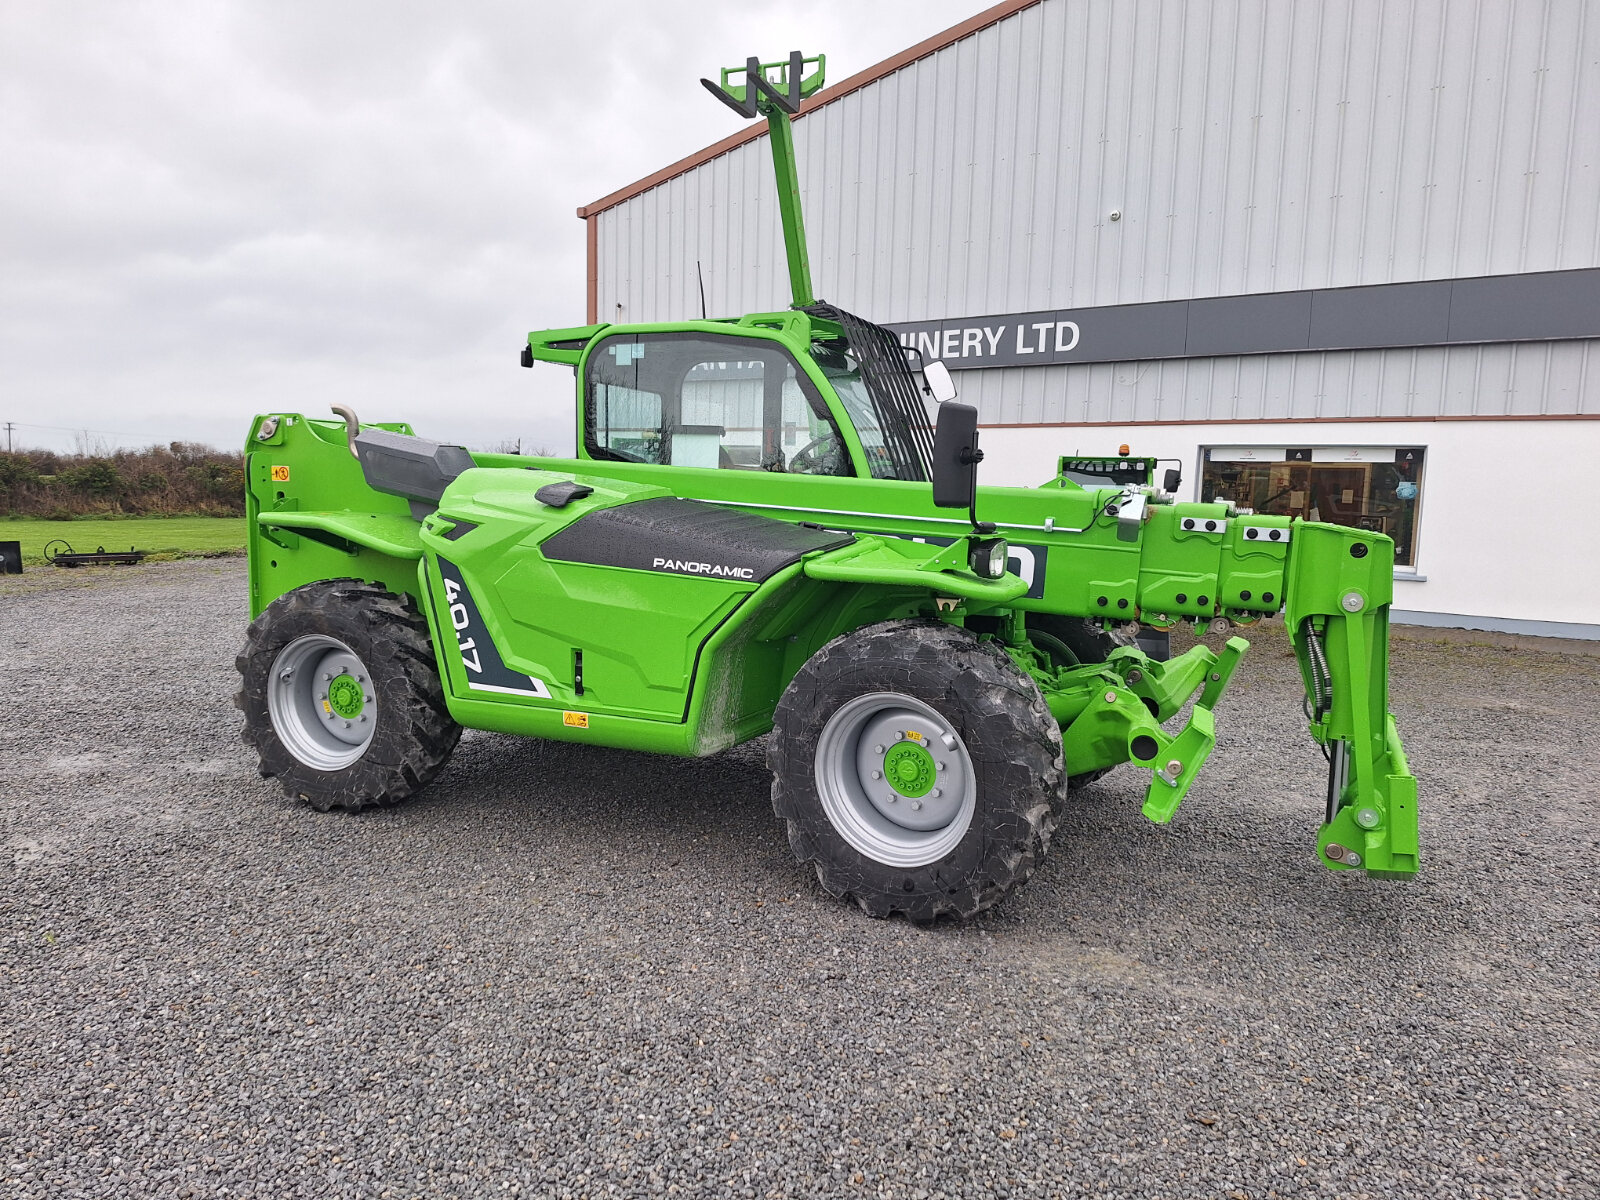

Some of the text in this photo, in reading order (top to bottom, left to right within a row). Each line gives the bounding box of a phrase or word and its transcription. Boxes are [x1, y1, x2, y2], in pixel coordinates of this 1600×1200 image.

[1016, 321, 1081, 355] LTD
[653, 557, 754, 579] PANORAMIC
[443, 578, 483, 674] 40.17
